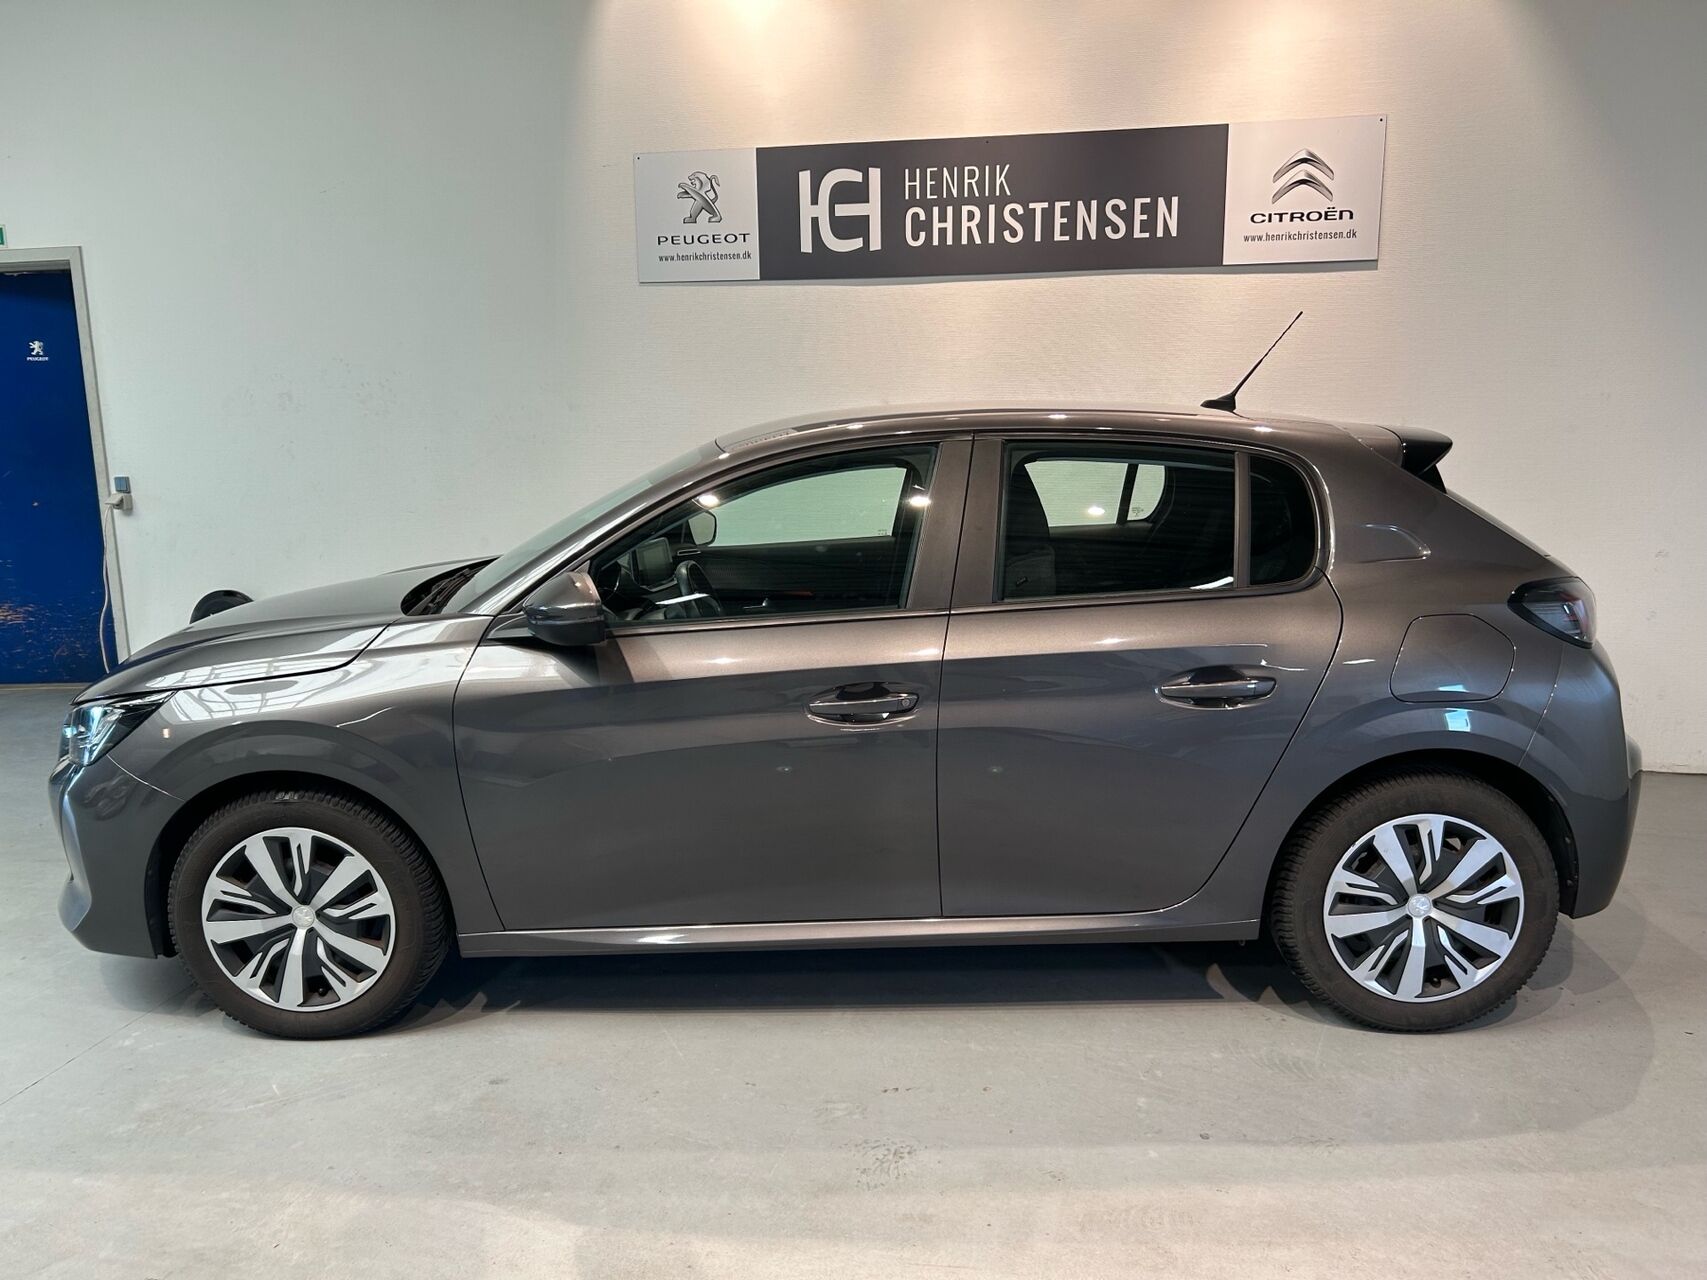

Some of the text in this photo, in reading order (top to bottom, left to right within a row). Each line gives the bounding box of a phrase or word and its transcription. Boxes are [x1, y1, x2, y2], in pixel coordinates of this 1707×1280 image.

[904, 163, 1011, 200] HENRIK
[904, 195, 1180, 247] CHRISTENSEN
[656, 232, 750, 246] PEUGEOT
[1243, 229, 1358, 243] www.henrikchristensen.dk
[658, 250, 752, 262] www.henrikchristensen.dk
